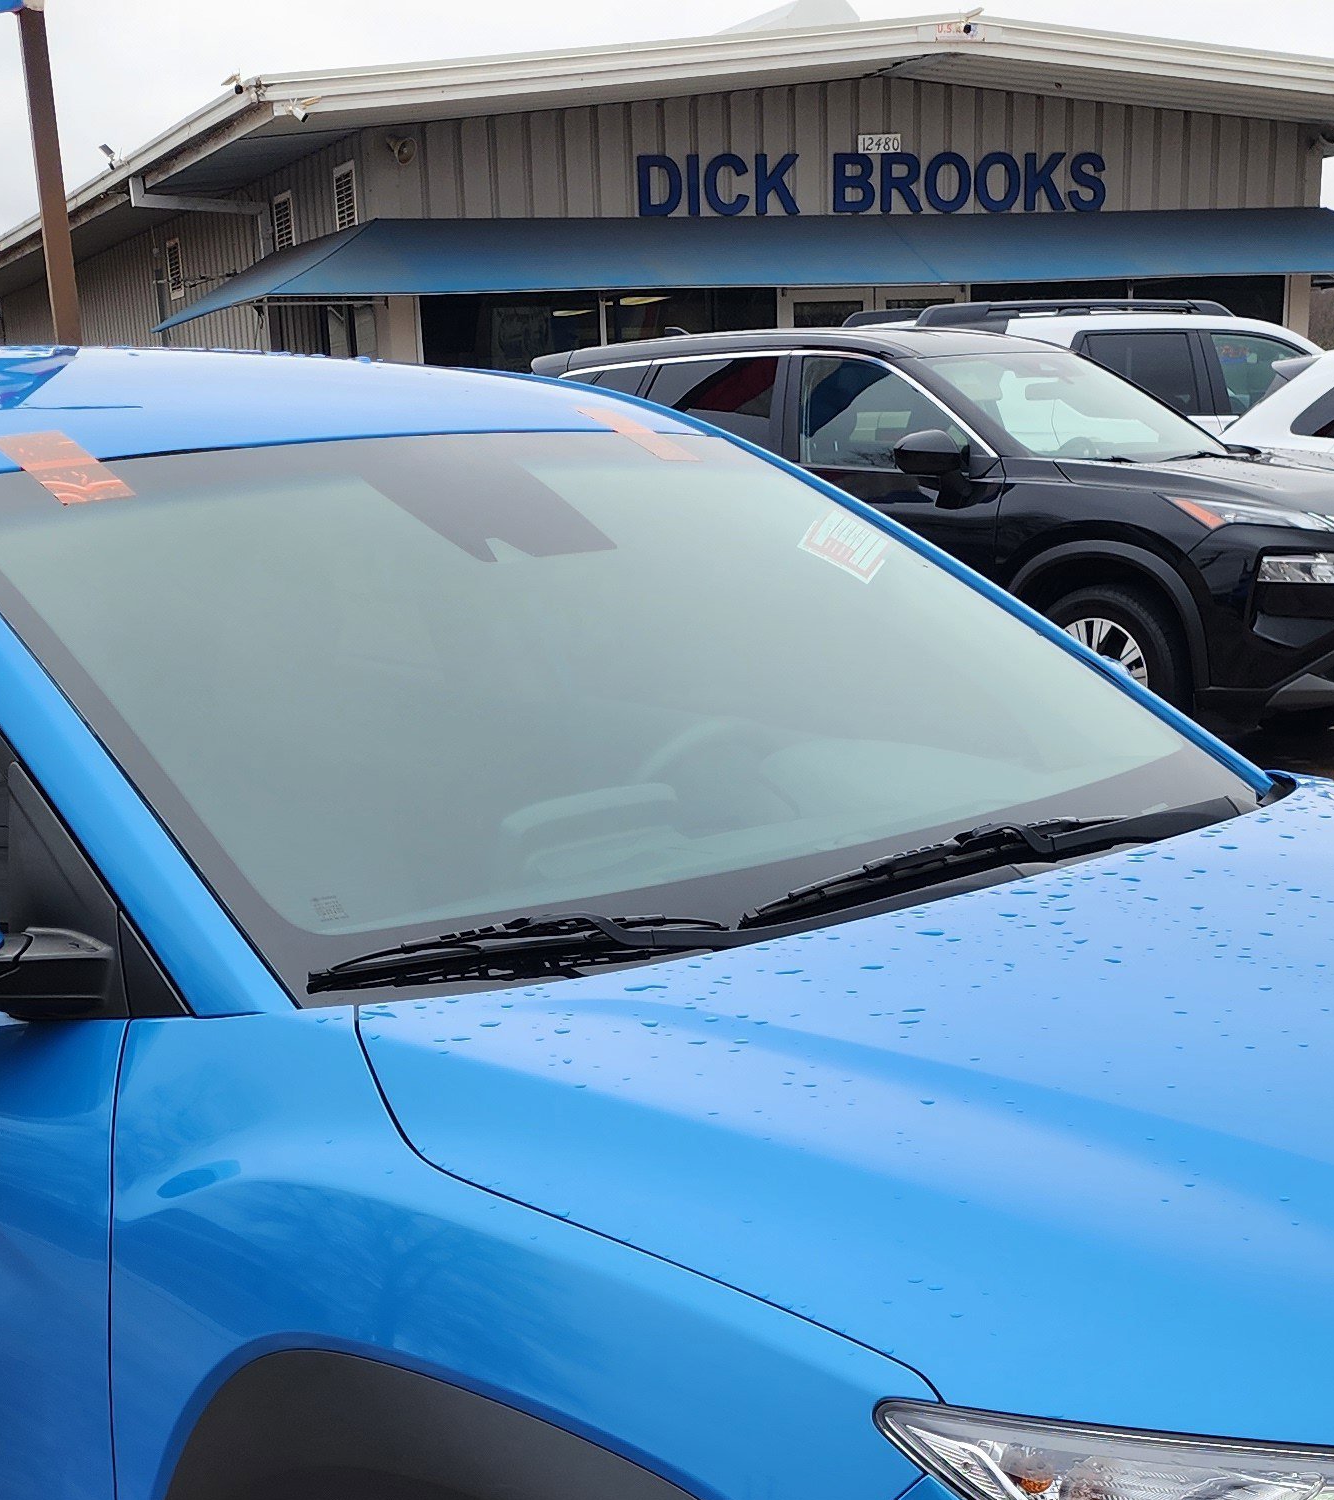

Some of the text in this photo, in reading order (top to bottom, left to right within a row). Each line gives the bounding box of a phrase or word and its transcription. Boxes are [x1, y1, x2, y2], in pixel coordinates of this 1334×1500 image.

[862, 137, 900, 152] 12480
[637, 152, 1106, 216] DICK BROOKS
